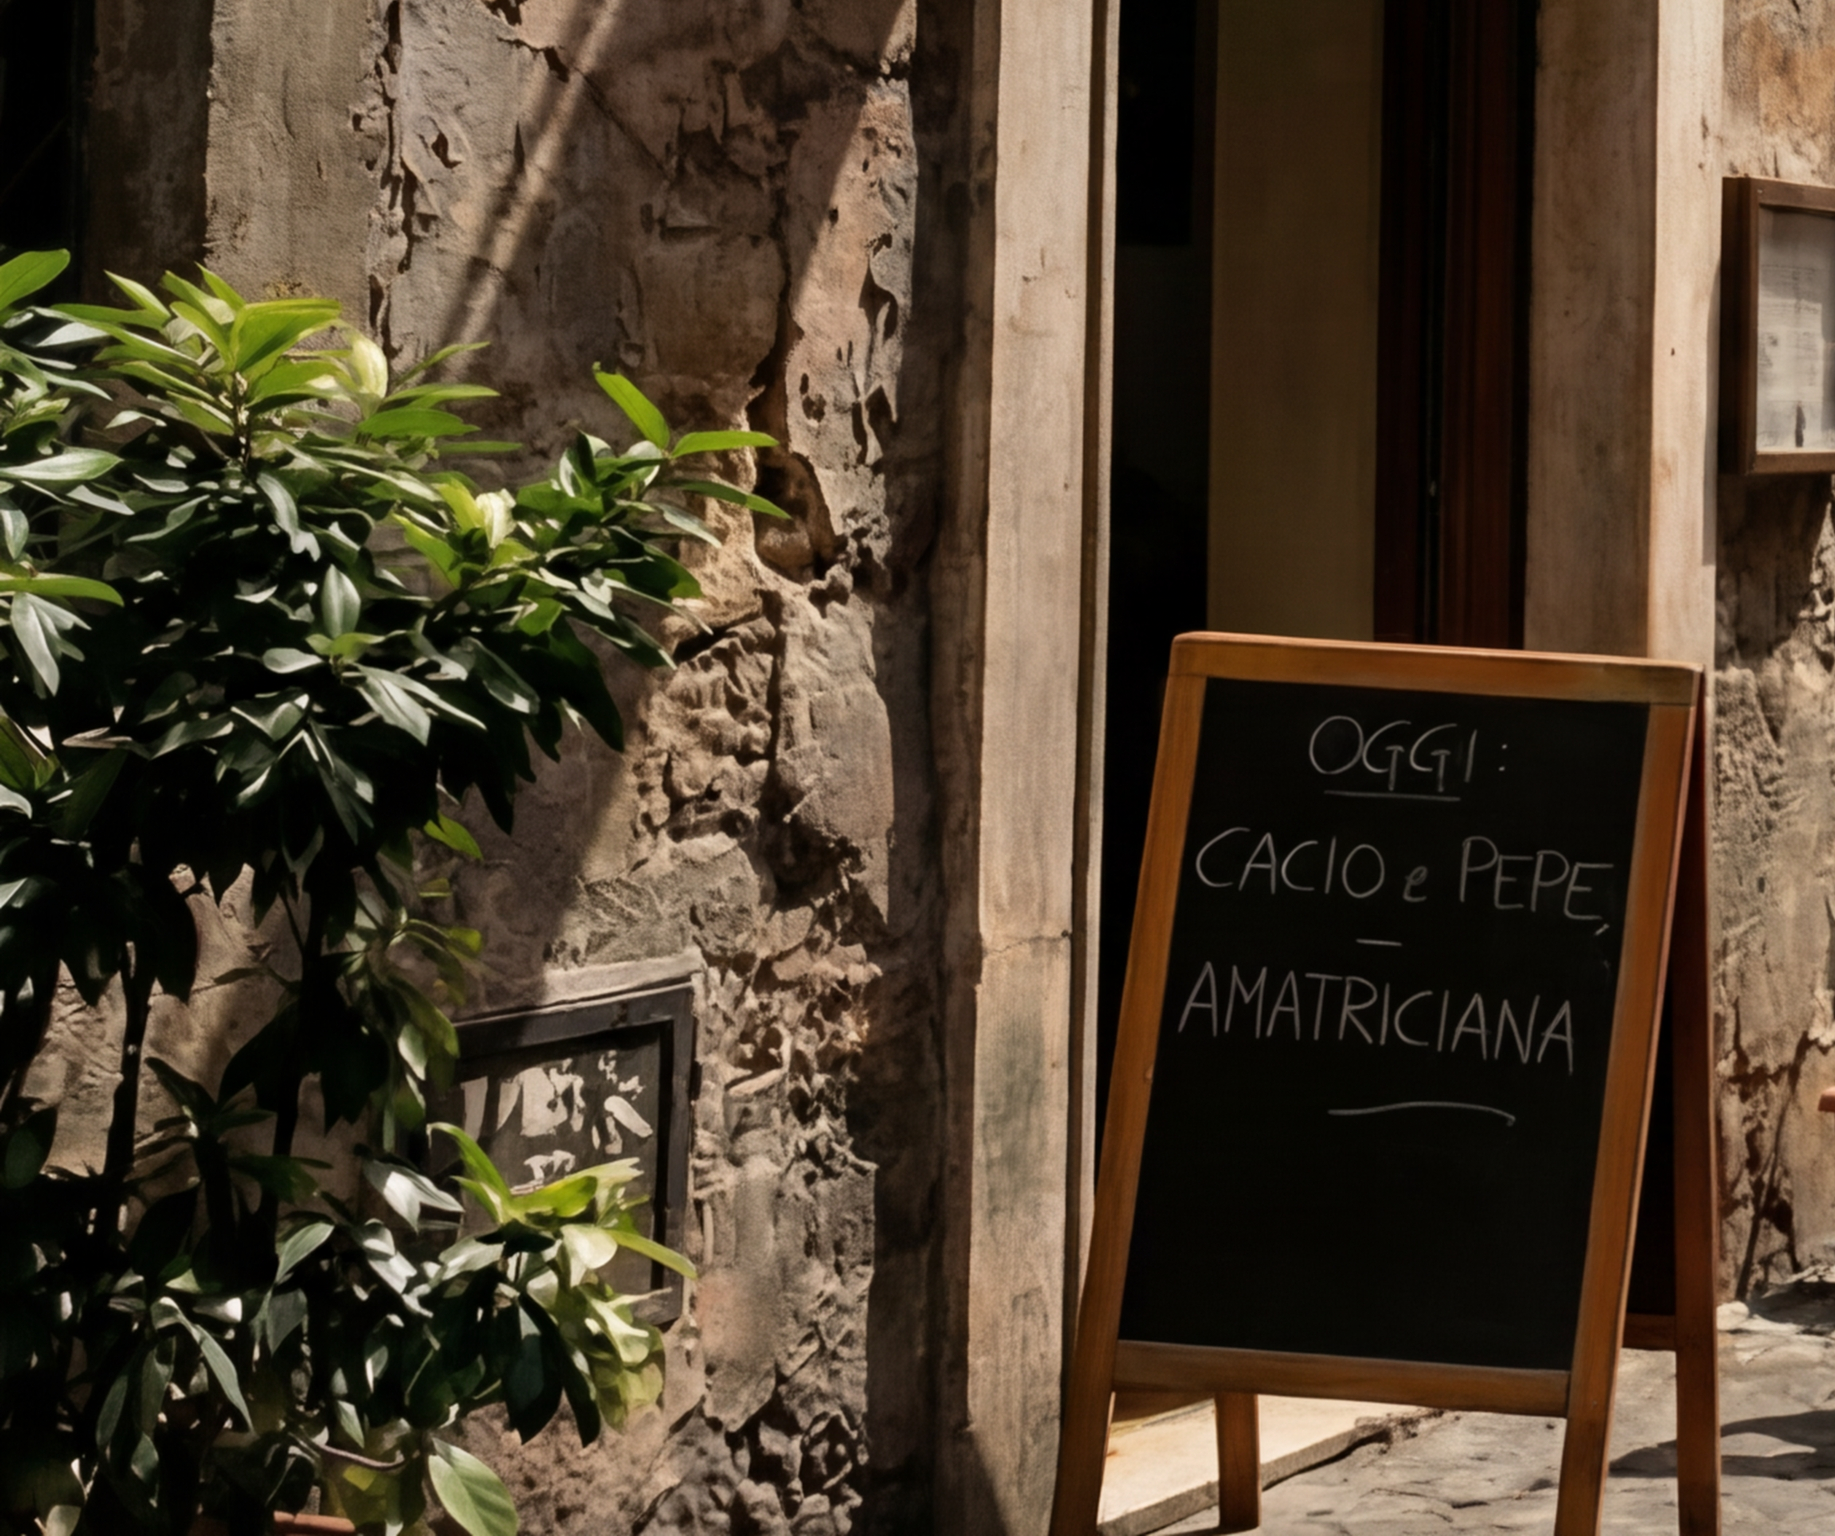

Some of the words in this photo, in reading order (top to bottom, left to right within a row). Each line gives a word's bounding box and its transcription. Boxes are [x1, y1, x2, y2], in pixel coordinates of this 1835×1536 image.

[1195, 827, 1386, 898] CACIO
[1402, 865, 1428, 902] e
[1460, 836, 1614, 936] PEPE,
[1179, 961, 1574, 1075] AMATRICIANA
